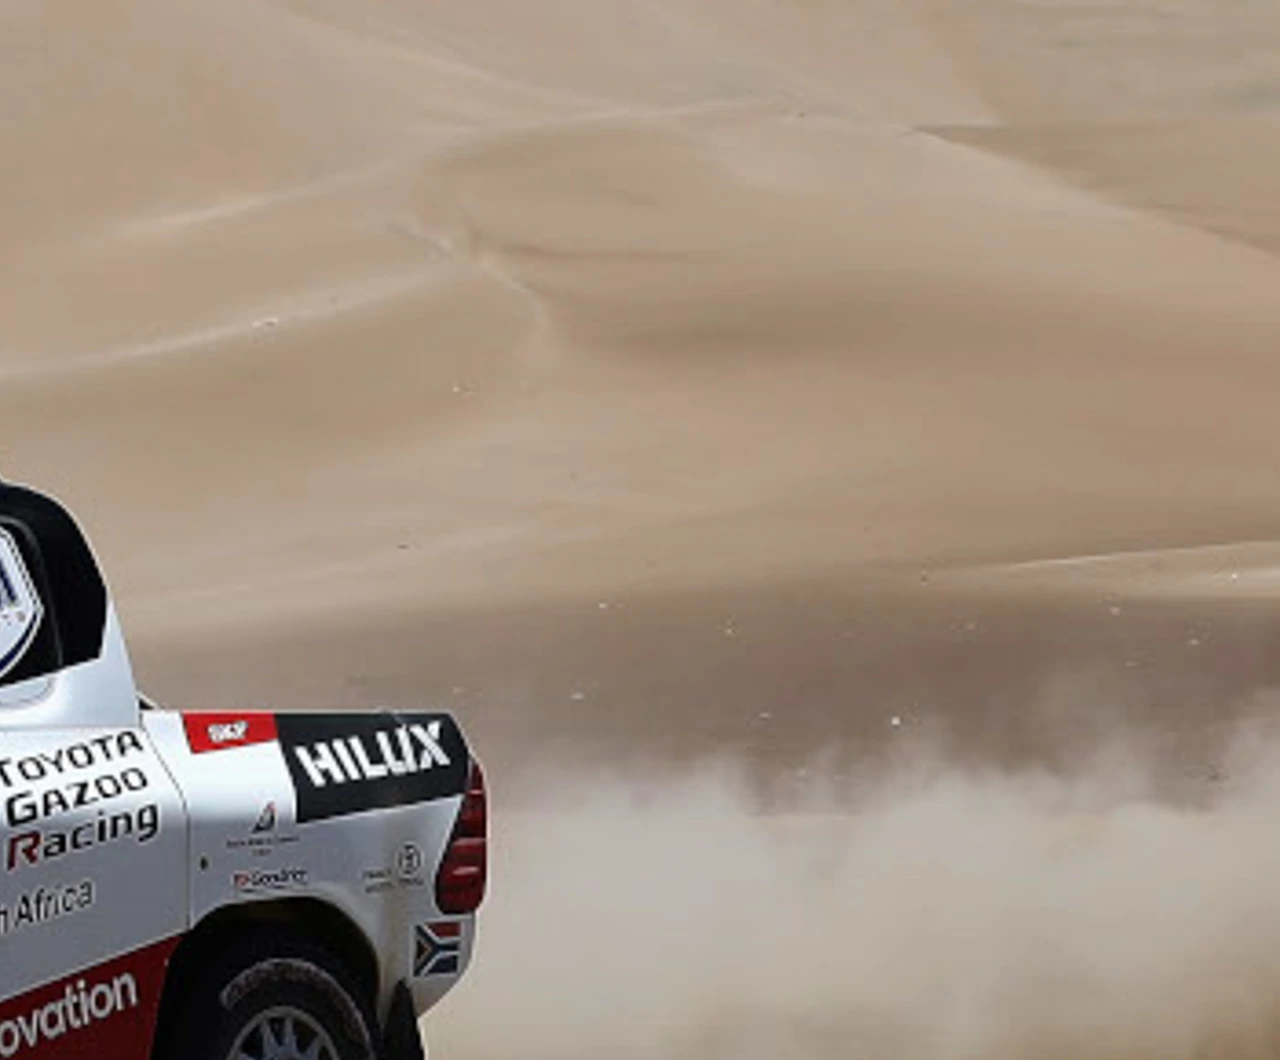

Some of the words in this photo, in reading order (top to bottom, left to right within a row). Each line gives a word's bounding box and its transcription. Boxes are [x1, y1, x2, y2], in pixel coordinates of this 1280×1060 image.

[295, 720, 450, 787] HILUX
[5, 768, 148, 827] GAZOO
[6, 804, 159, 870] Racing
[14, 879, 94, 926] Africa
